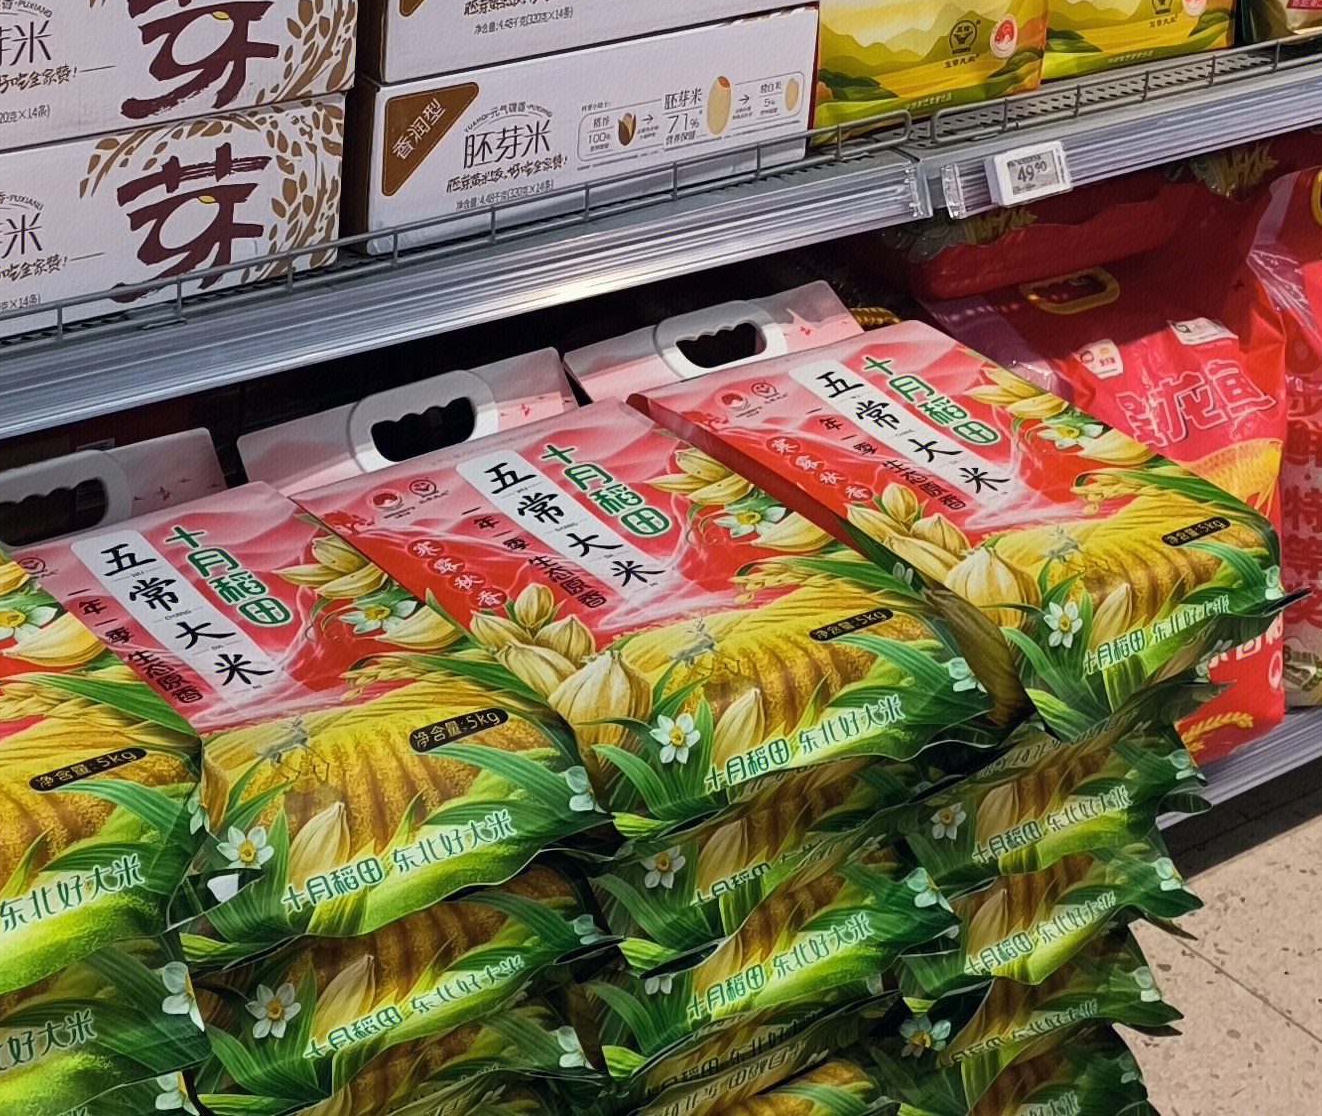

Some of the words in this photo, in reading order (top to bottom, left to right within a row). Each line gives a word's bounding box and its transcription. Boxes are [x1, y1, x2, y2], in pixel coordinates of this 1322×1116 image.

[393, 97, 447, 161] 香润型
[464, 118, 551, 169] 胚芽米
[664, 88, 703, 110] 胚芽米
[110, 143, 272, 303] 芽
[816, 370, 1013, 493] 五常大米
[862, 354, 999, 447] 十月稻田
[489, 462, 666, 586] 五常大米
[539, 444, 670, 535] 十月稻田
[68, 590, 135, 645] 一年一季
[102, 542, 275, 686] 五常大米
[163, 525, 292, 626] 十月稻田
[1085, 629, 1146, 673] 十月稻田
[1152, 595, 1229, 645] 东北好大米
[706, 737, 790, 791] 十月稻田
[798, 695, 905, 755] 东北好大米
[281, 856, 385, 914] 十月稻田
[392, 810, 513, 872] 东北好大米
[974, 815, 1043, 862] 十月稻田
[1048, 786, 1133, 832] 东北好大米
